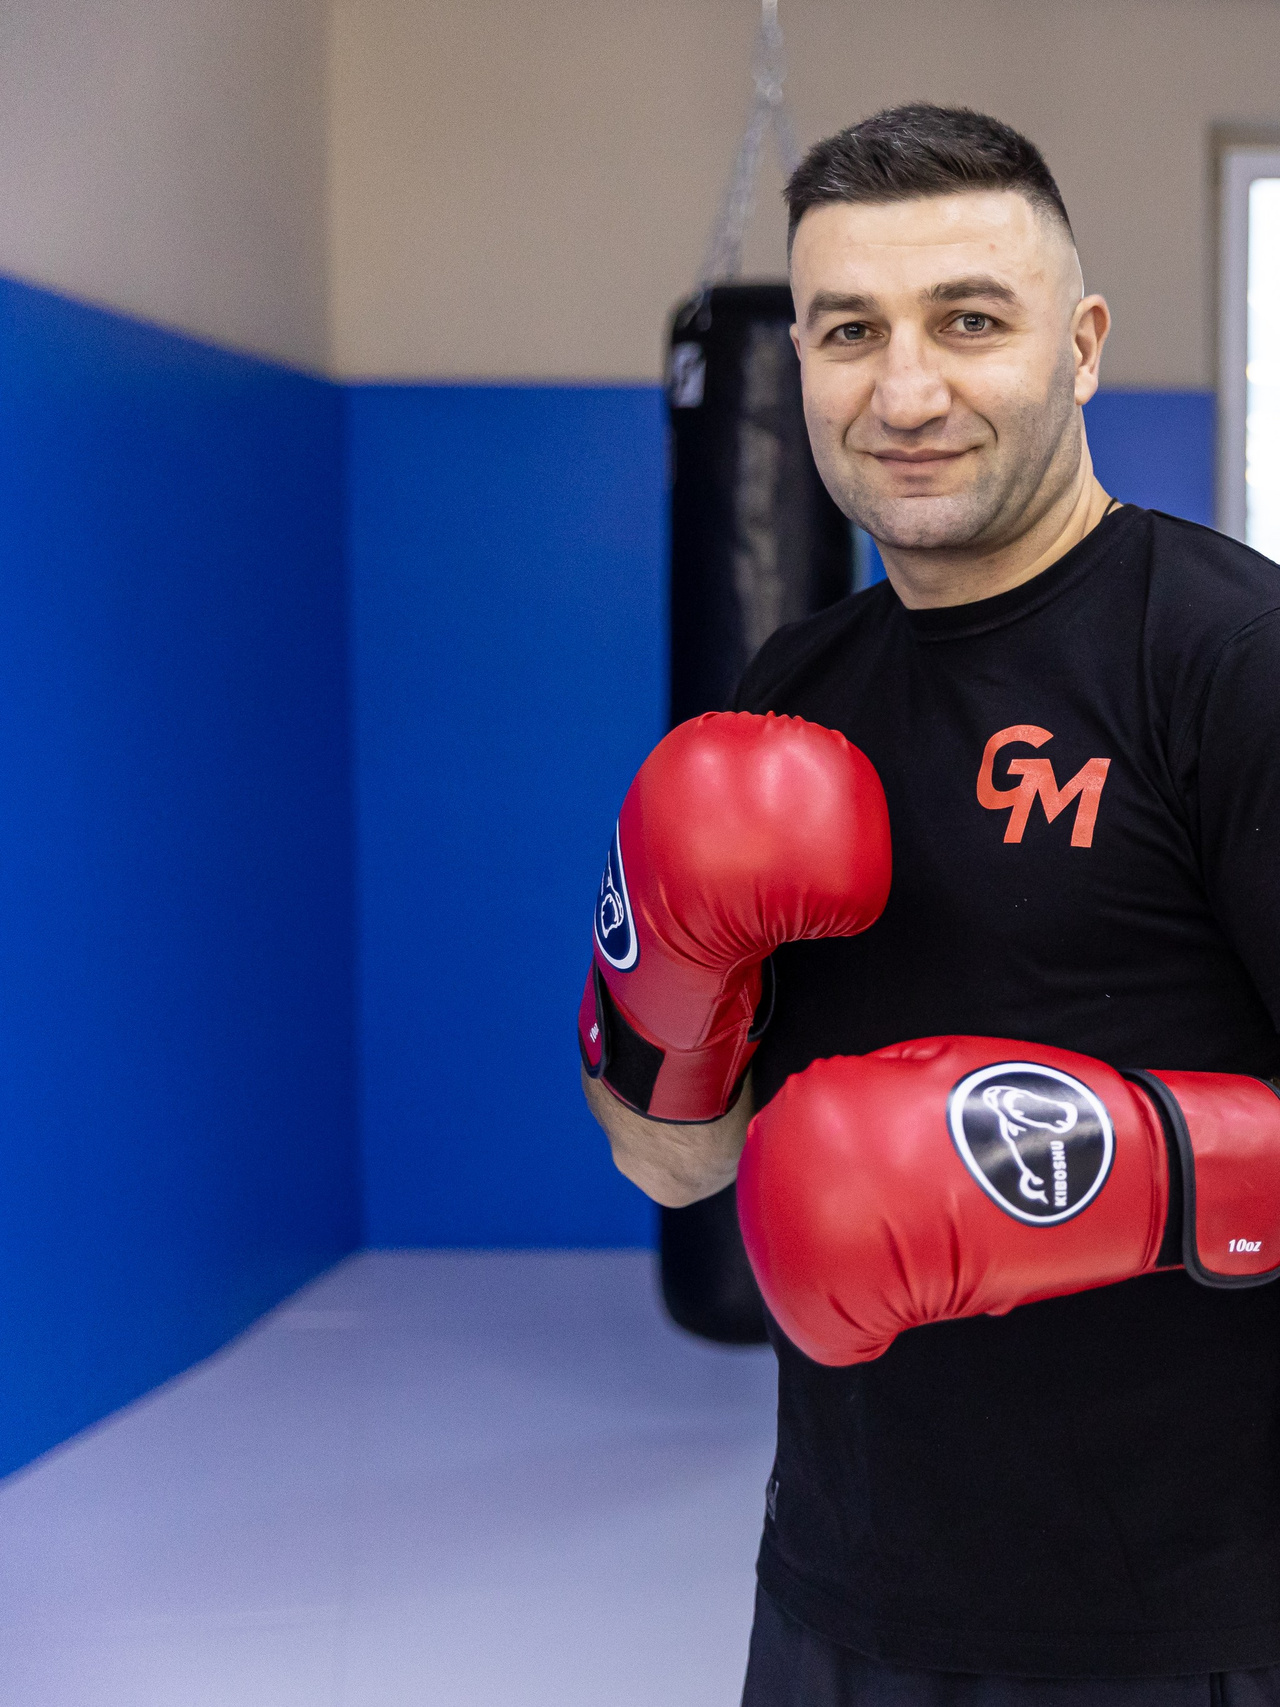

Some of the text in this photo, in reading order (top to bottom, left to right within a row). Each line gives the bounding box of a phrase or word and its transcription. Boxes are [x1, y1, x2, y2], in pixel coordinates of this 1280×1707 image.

[976, 724, 1111, 848] GM
[1050, 1141, 1068, 1207] KIBOSHU
[1228, 1238, 1262, 1253] 10oz
